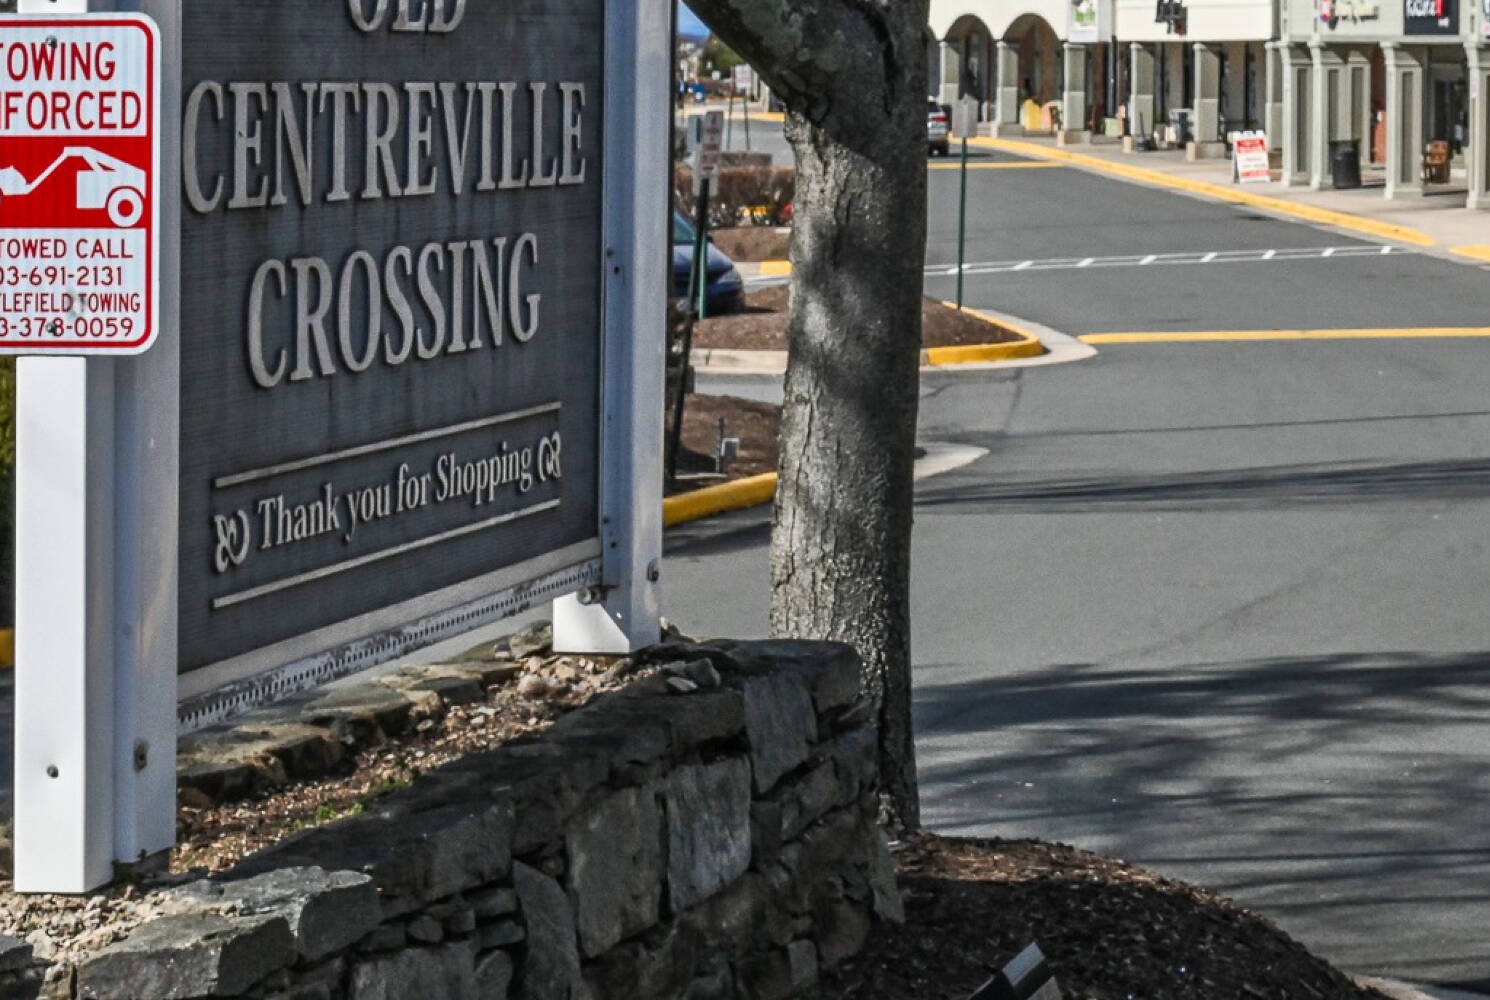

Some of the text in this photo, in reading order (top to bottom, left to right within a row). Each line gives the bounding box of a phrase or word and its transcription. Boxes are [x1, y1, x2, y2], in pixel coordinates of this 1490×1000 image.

[0, 41, 116, 82] OWING
[0, 90, 141, 130] FORCED
[182, 79, 587, 214] CENTREVILLE
[76, 238, 133, 259] CALL
[0, 292, 141, 313] LEFIELD TOWING
[249, 233, 541, 388] CROSSING
[257, 440, 534, 550] Thank you for Shopping
